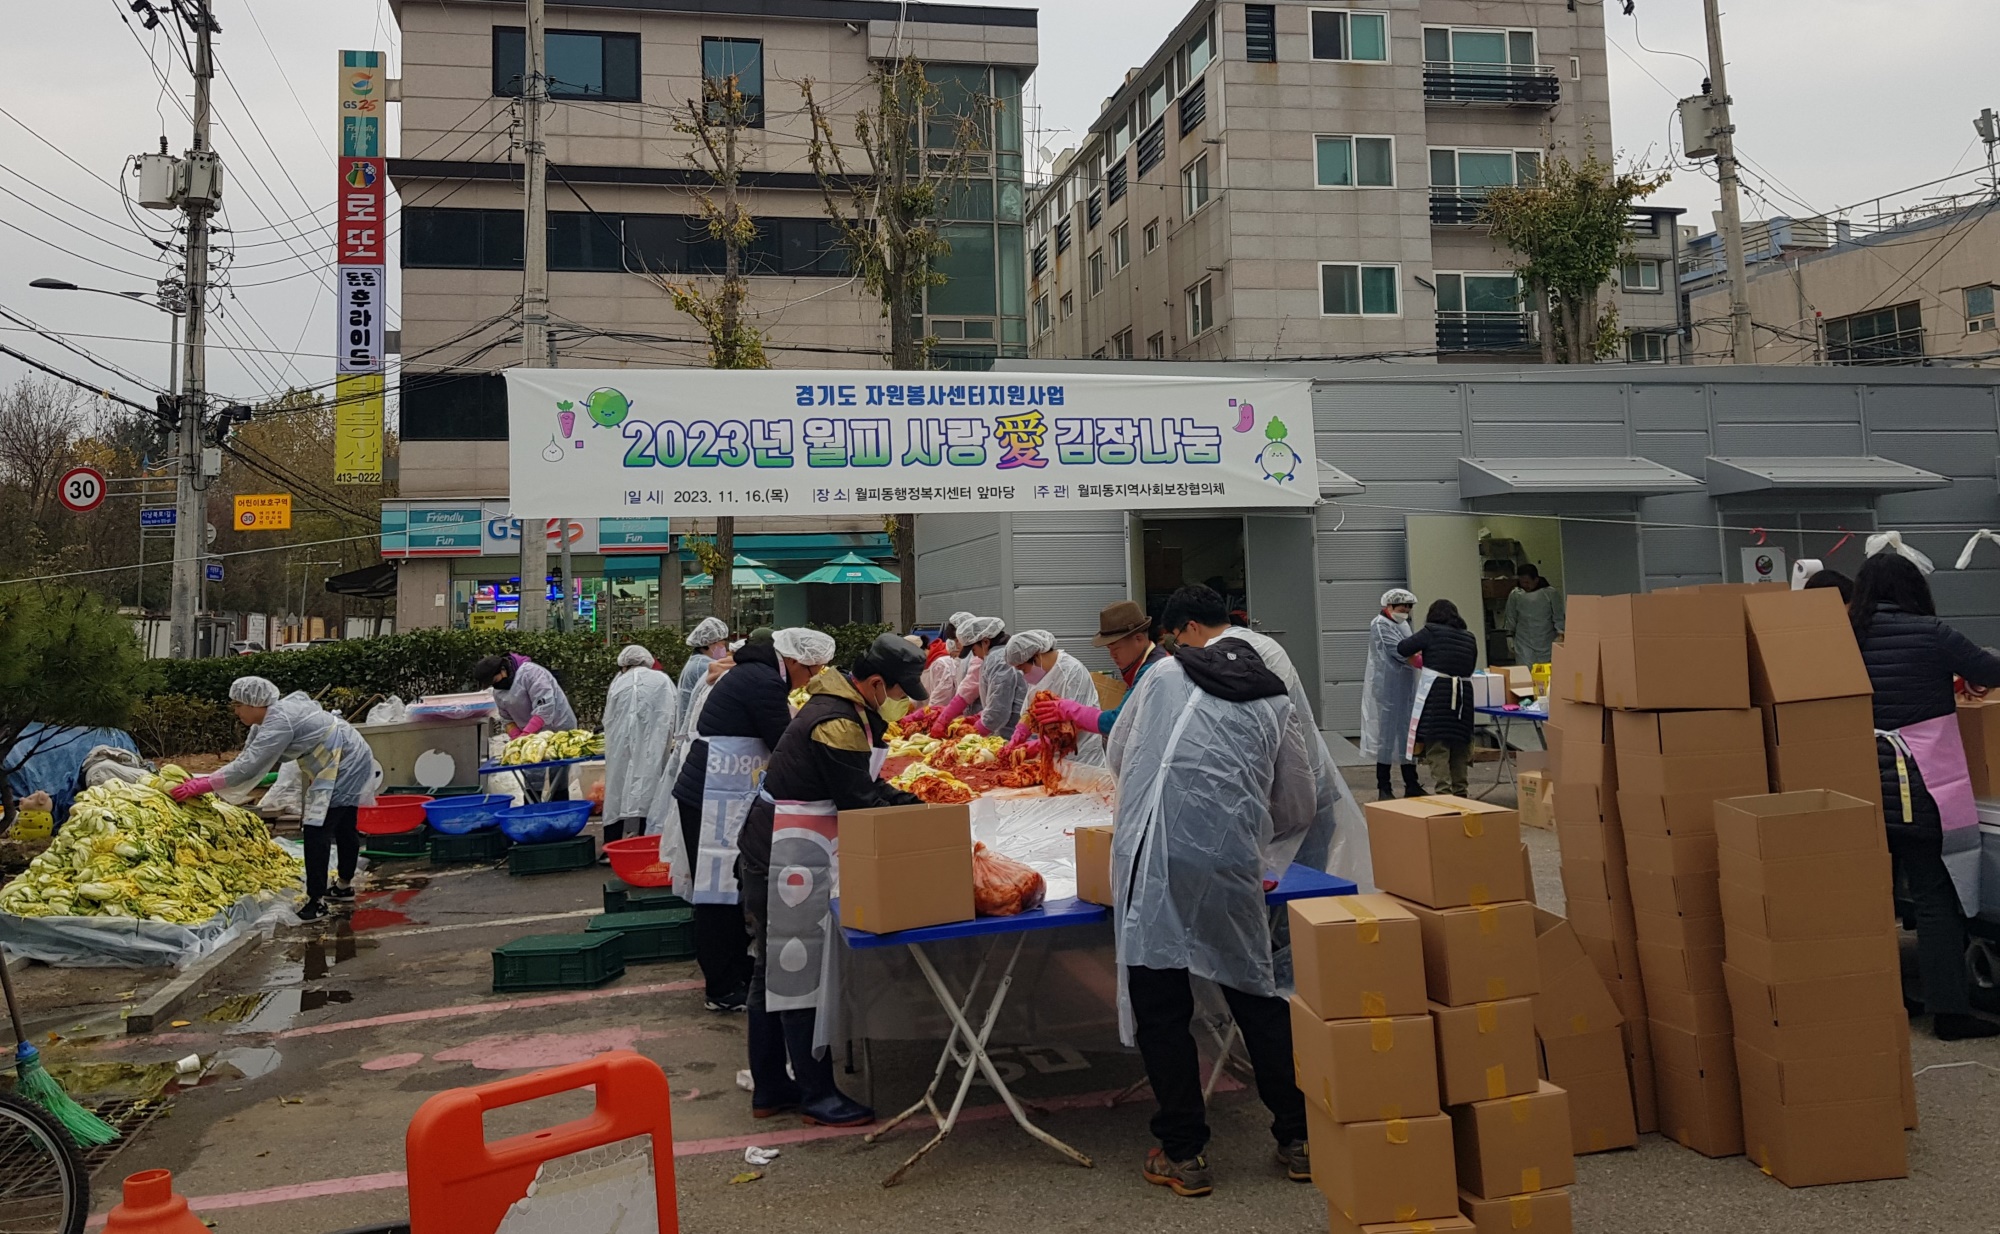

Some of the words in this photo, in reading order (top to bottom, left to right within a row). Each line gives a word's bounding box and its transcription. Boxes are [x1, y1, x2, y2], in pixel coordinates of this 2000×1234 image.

[345, 193, 377, 257] 로또
[796, 385, 857, 406] 경기도
[865, 385, 1065, 406] 자원봉사센터지원사업
[622, 419, 794, 468] 2023년
[802, 418, 892, 468] 월피
[1055, 417, 1222, 464] 김장나눔
[336, 472, 380, 483] 413-0222
[70, 481, 95, 499] 30
[673, 490, 712, 503] 2023.
[718, 490, 739, 503] 11.
[744, 488, 789, 503] 16.(목)
[855, 486, 972, 502] 월피동행정복지센터
[977, 485, 1016, 499] 앞마당
[1077, 483, 1226, 498] 월피동지역사회보장협의체
[238, 498, 288, 507] 어린이보호구역
[426, 512, 464, 523] Friendly
[435, 536, 454, 546] Fun
[625, 533, 643, 543] Fun
